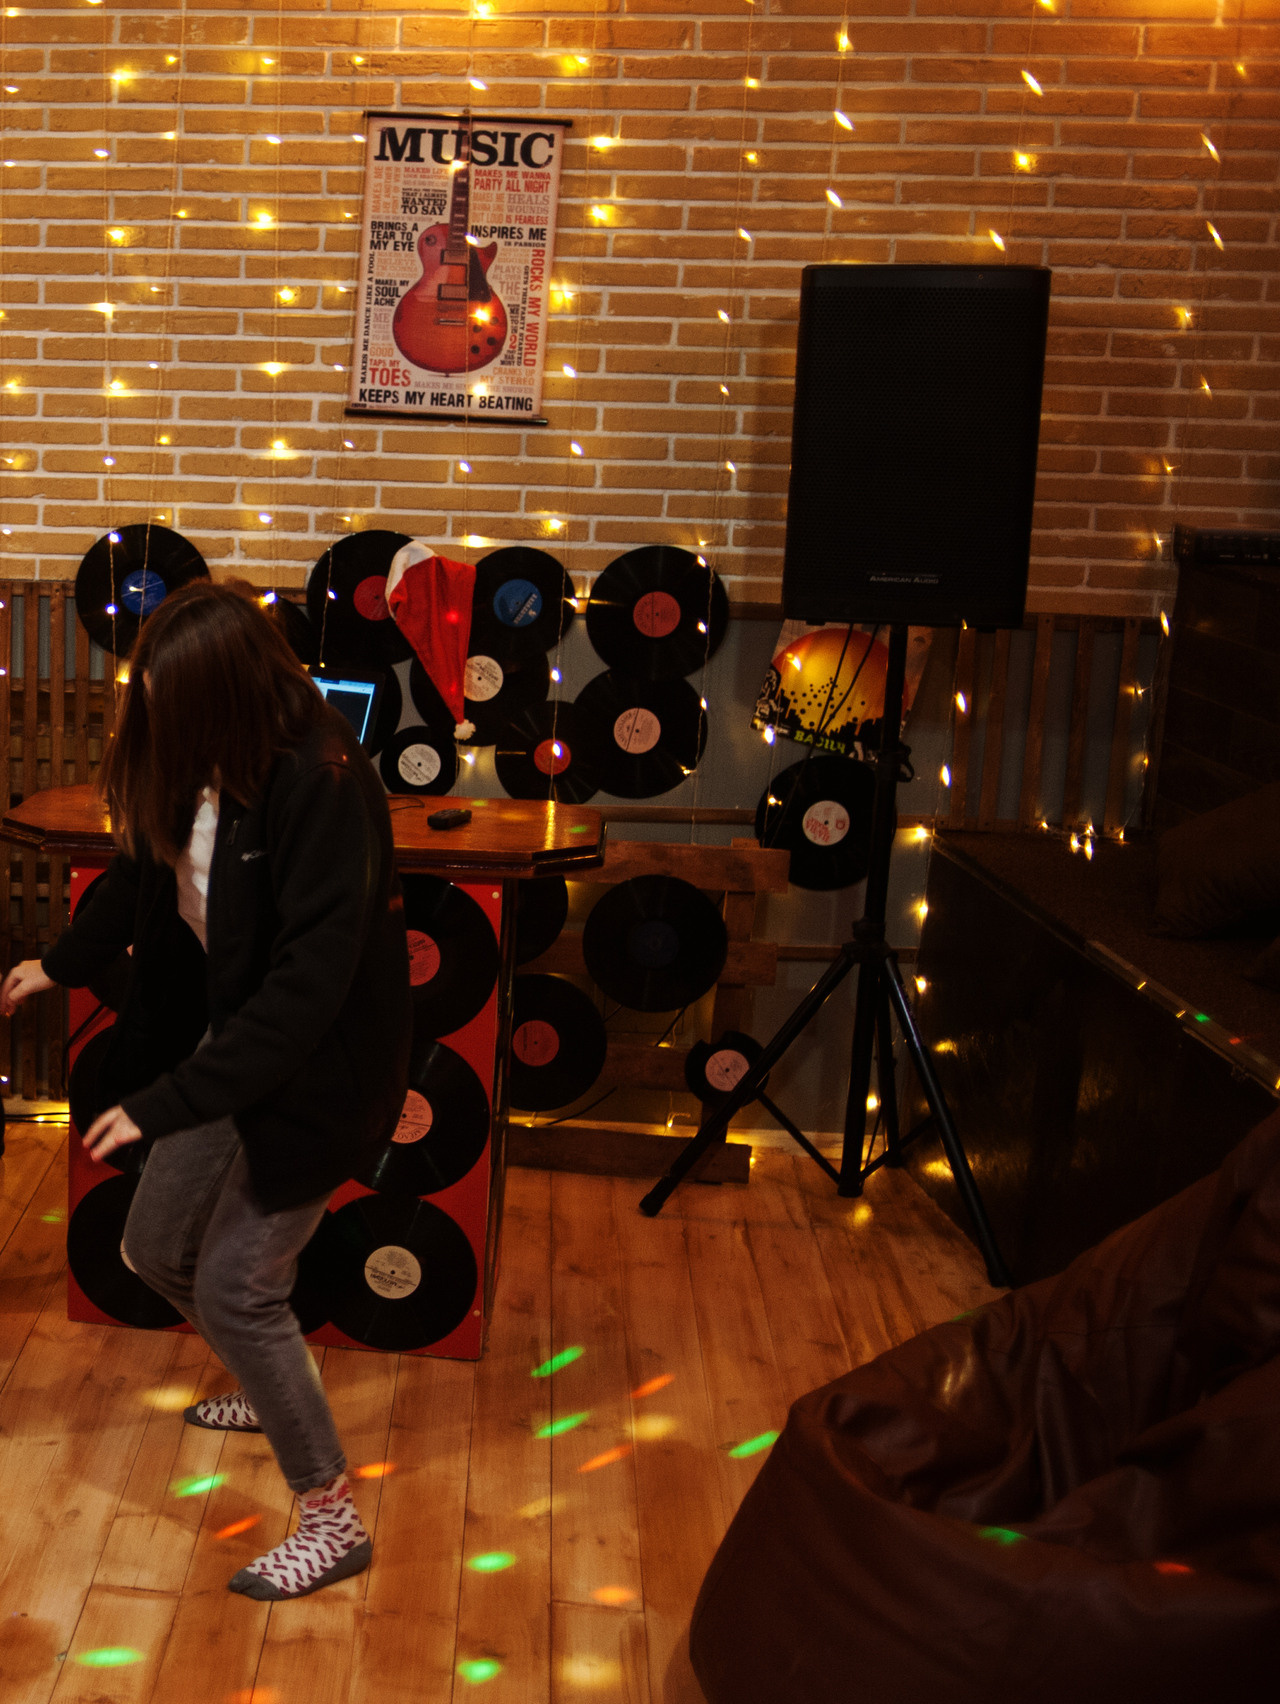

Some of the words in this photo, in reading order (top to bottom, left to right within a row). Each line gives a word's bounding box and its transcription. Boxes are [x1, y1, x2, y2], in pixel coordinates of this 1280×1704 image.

[373, 127, 555, 169] MUSIC
[474, 169, 502, 178] MAKES
[506, 170, 519, 179] ME
[521, 171, 551, 180] WANNA
[474, 178, 503, 191] PARTY
[505, 180, 521, 192] ALL
[524, 180, 550, 193] NIGHT
[402, 197, 447, 206] WANTED
[507, 194, 550, 205] HEALS
[401, 205, 418, 214] TO
[421, 206, 446, 216] SAY
[507, 205, 549, 215] WOUNDS
[371, 221, 407, 232] BRINGS
[411, 222, 419, 232] A
[505, 214, 513, 223] IS
[514, 215, 549, 225] FEARLESS
[371, 230, 399, 240] TEAR
[401, 231, 413, 241] TO
[471, 225, 524, 240] INSPIRES
[528, 227, 547, 241] ME
[370, 240, 389, 251] MY
[393, 241, 415, 252] EYE
[529, 248, 546, 291] ROCKS
[365, 285, 373, 305] LIKE
[375, 286, 401, 298] SOUL
[499, 281, 521, 295] THE
[374, 298, 396, 306] ACHE
[527, 297, 541, 317] MY
[363, 307, 372, 337] DANCE
[519, 307, 527, 331] PARTY
[362, 338, 369, 352] ME
[508, 334, 518, 350] 2
[516, 332, 524, 366] STARTED
[523, 322, 540, 367] WORLD
[360, 353, 368, 384] MAKES
[369, 358, 387, 367] TAPS
[369, 367, 412, 387] TOES
[499, 376, 535, 386] STEREO
[359, 388, 400, 404] KEEPS
[404, 391, 426, 405] MY
[430, 392, 474, 408] HEART
[478, 395, 533, 411] BEATING
[869, 575, 912, 583] AMERICAN
[913, 576, 939, 584] AUDIO
